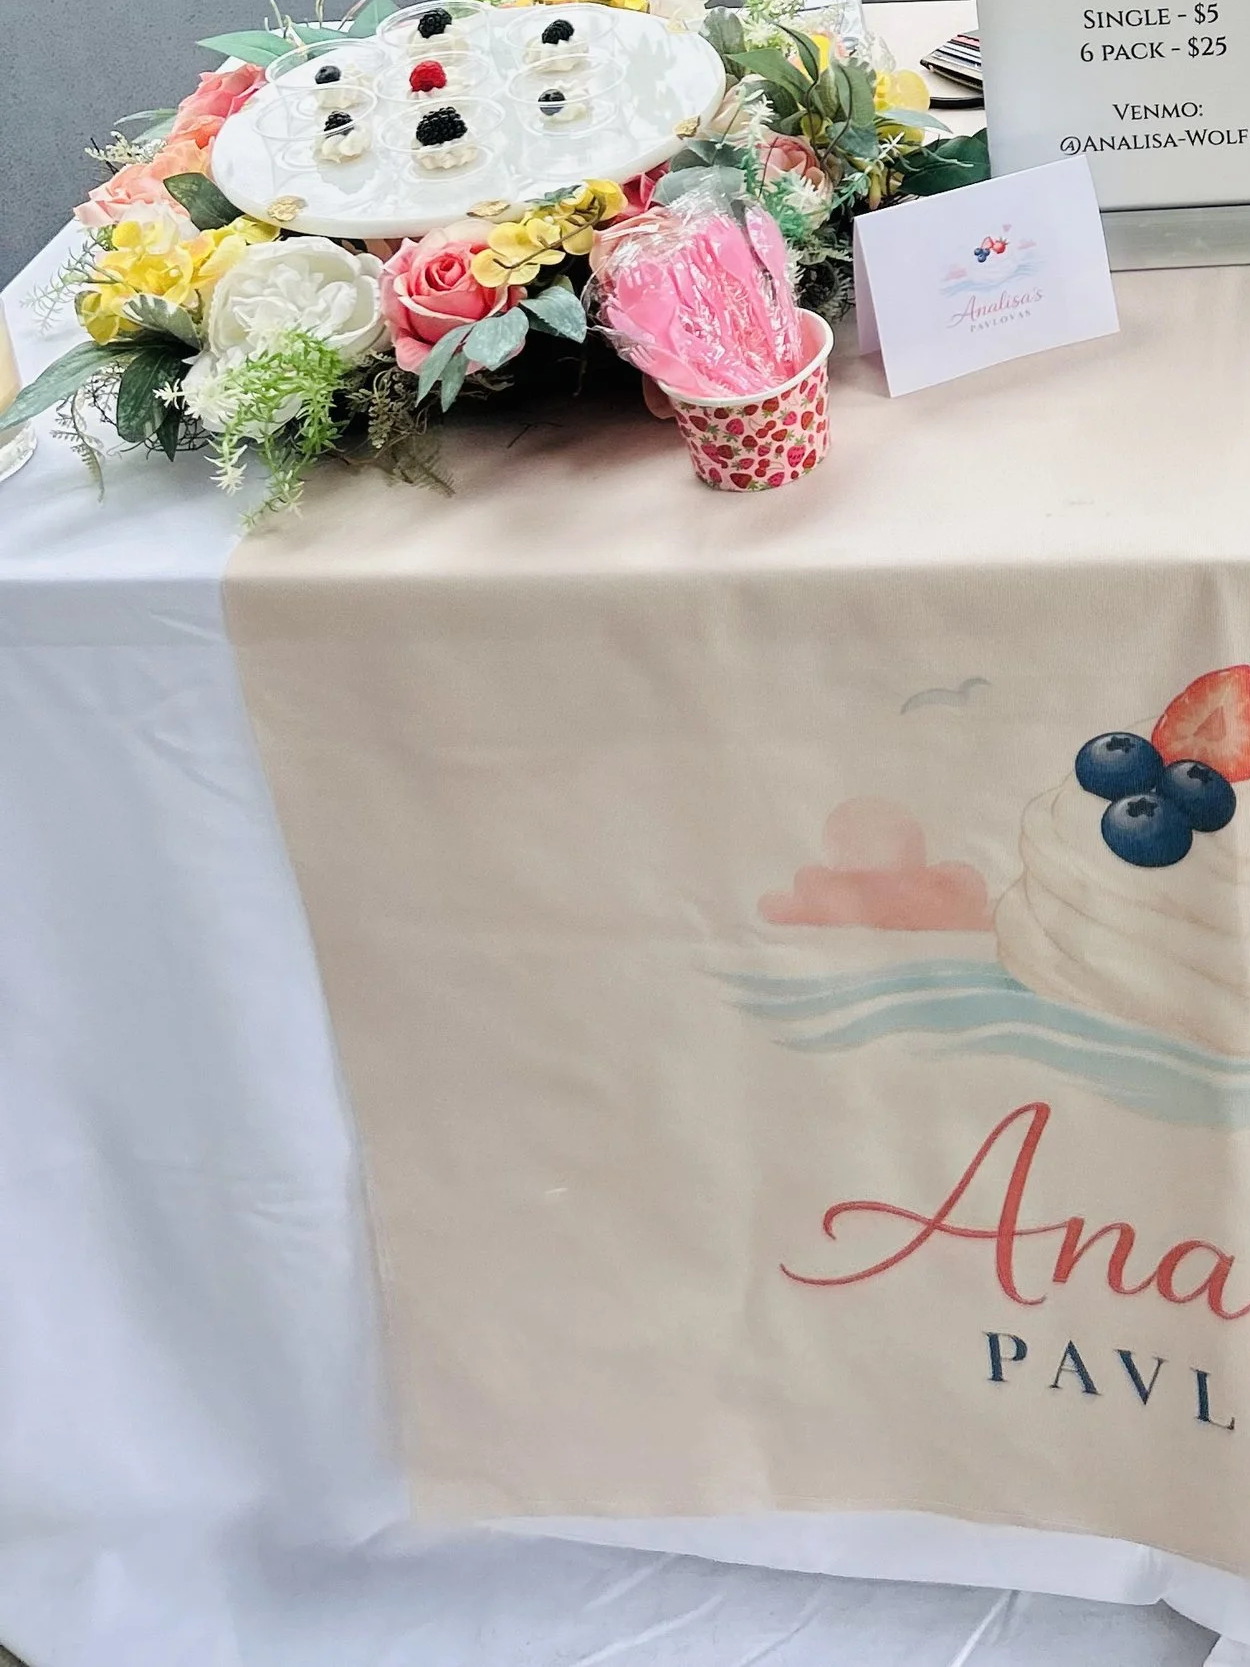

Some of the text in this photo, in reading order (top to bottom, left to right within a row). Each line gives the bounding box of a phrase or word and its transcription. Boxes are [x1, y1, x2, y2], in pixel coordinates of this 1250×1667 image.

[1083, 7, 1172, 30] SINGLE
[1193, 1, 1219, 26] $5
[1079, 42, 1095, 63] 6
[1101, 41, 1167, 62] PACK
[1187, 35, 1228, 59] $25
[1111, 101, 1204, 122] VENMO:
[947, 287, 1044, 329] Analisa's
[969, 309, 1031, 333] PAVLOVAS
